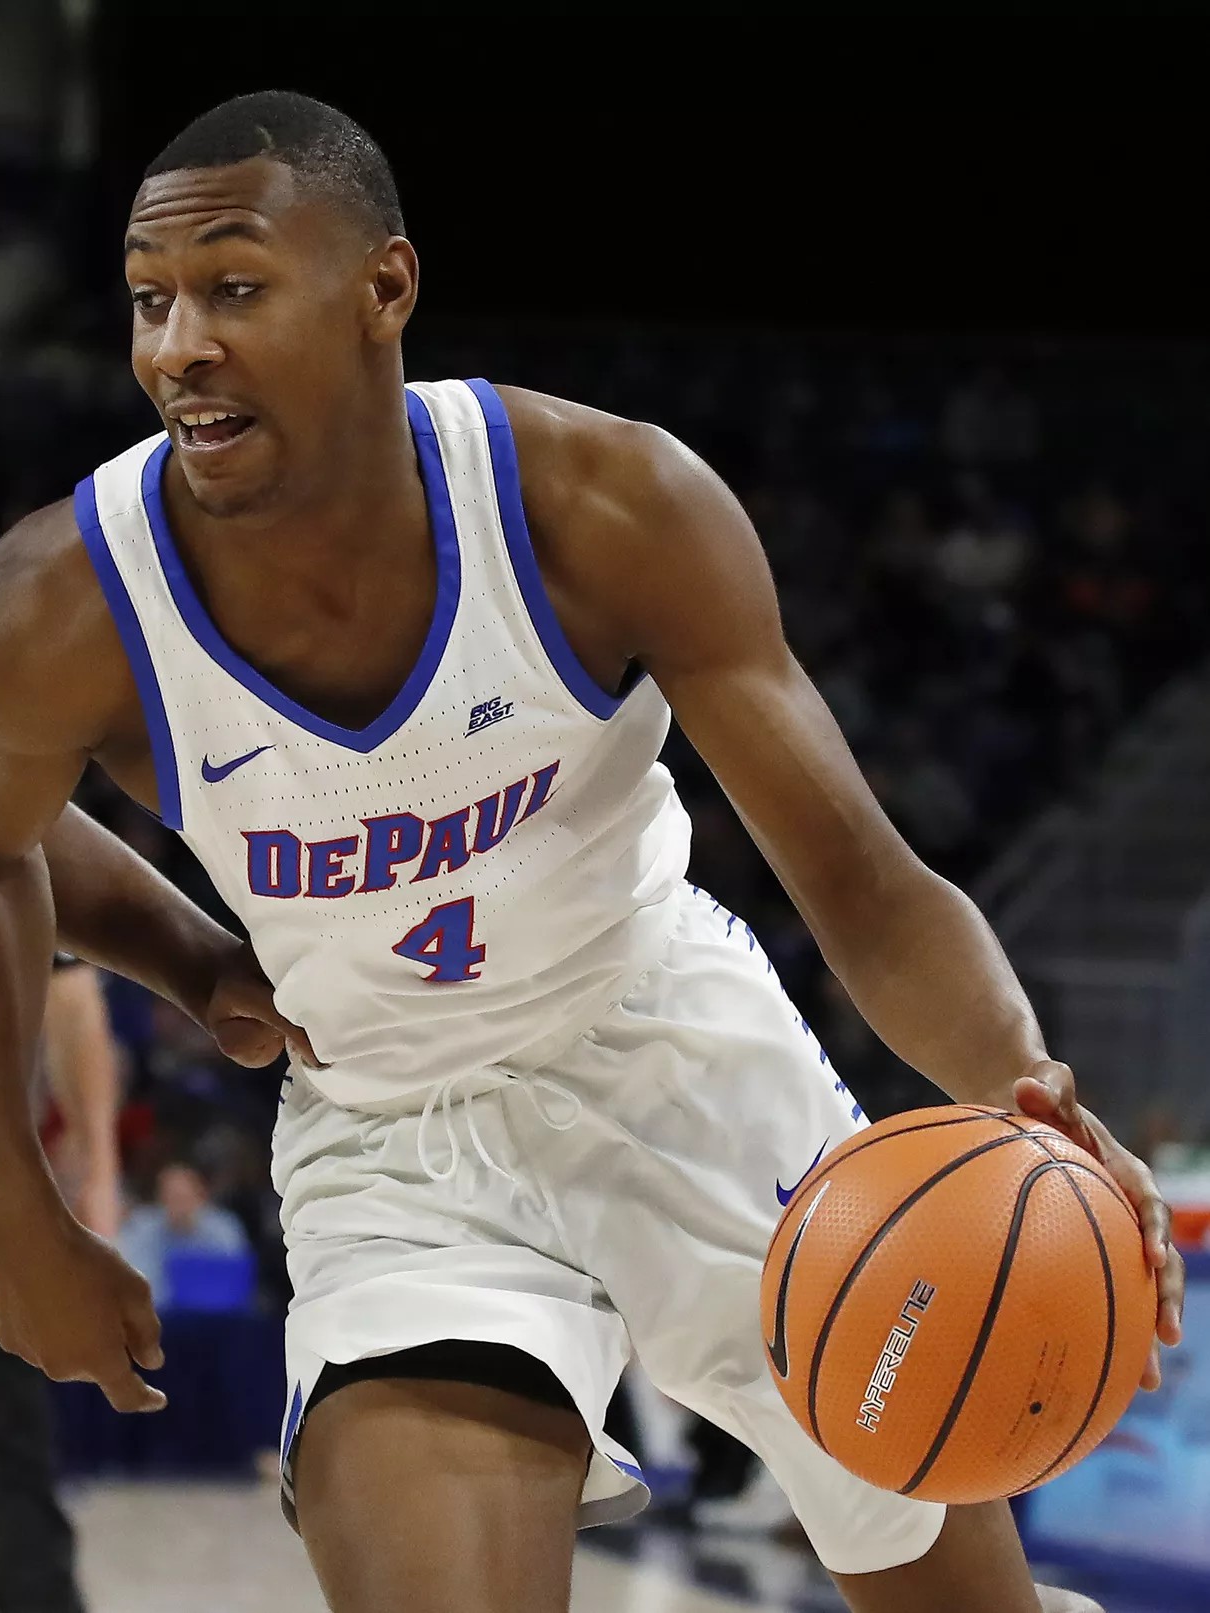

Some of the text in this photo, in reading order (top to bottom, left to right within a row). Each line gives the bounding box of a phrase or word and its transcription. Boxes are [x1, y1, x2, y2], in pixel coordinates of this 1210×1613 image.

[468, 702, 514, 730] EAST
[470, 696, 501, 719] BIG
[391, 896, 486, 982] 4
[856, 1278, 937, 1433] HYPERELITE
